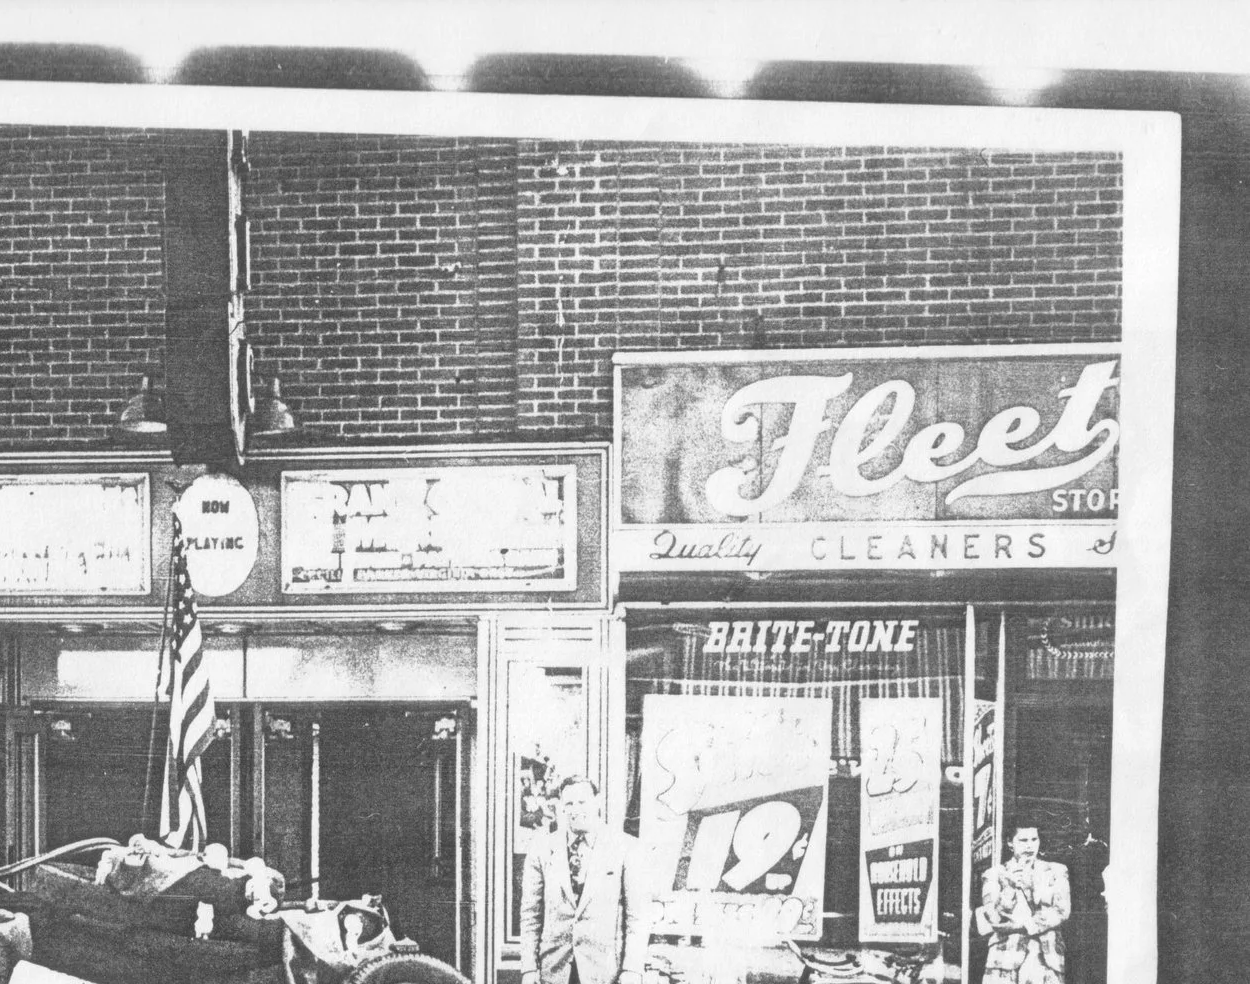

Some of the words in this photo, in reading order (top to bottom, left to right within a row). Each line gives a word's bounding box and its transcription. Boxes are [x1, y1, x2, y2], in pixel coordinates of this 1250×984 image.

[706, 360, 1119, 517] Fleet
[202, 500, 230, 514] NOW
[649, 529, 762, 567] Quality
[811, 532, 1046, 560] CLEANERS
[702, 620, 919, 653] BRITE-TONE
[877, 888, 921, 915] EFFECTS
